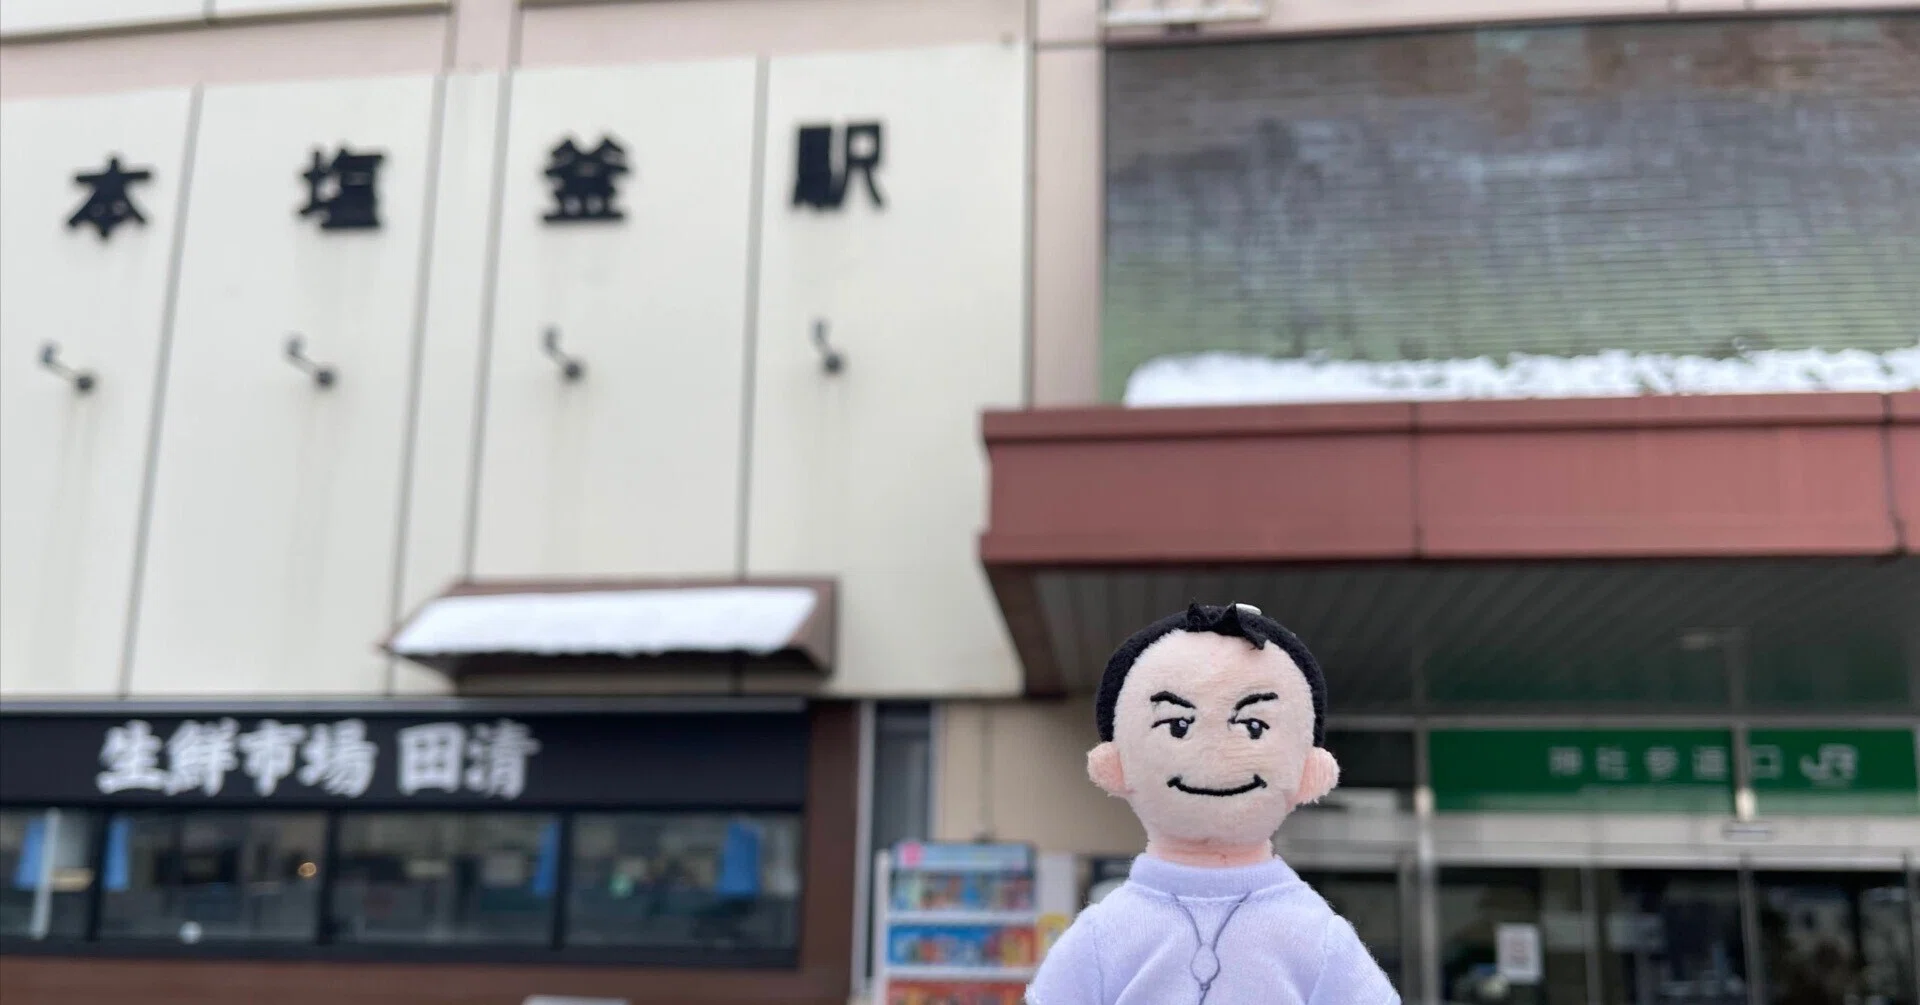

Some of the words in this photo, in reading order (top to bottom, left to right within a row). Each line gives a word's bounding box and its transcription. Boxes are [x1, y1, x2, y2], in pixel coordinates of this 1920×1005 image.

[66, 121, 884, 241] 本塩釜駅
[96, 716, 381, 797] 生鮮市場
[397, 718, 540, 798] 田清
